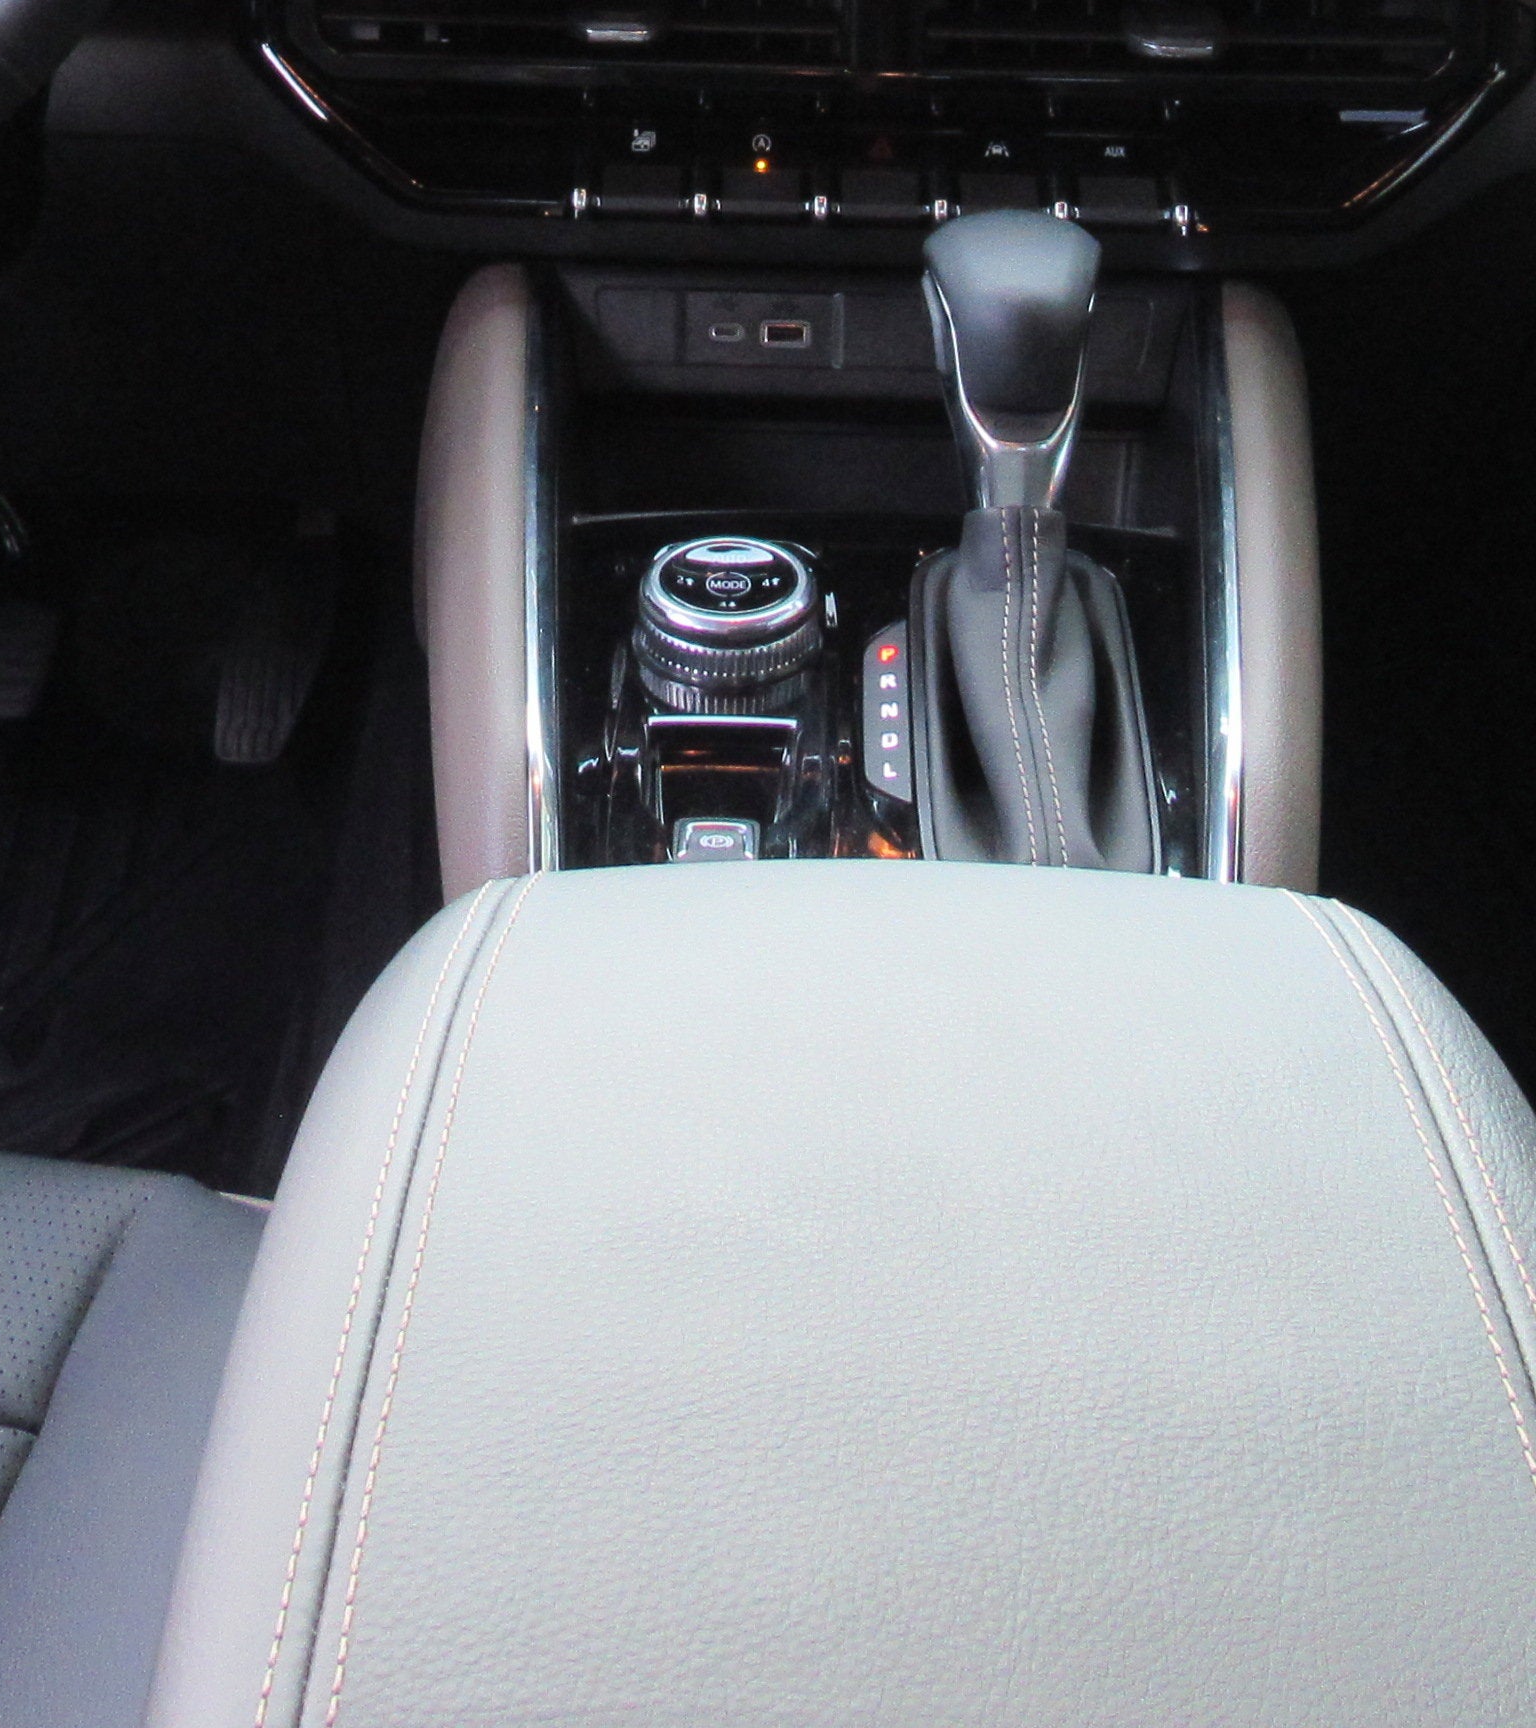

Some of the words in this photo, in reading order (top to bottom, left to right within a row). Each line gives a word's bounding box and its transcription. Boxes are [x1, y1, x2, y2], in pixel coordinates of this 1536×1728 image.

[1104, 145, 1127, 158] AUX
[710, 579, 747, 590] MODE
[877, 646, 898, 662] P
[880, 674, 897, 688] R
[881, 703, 898, 718] N
[881, 733, 898, 749] D
[882, 764, 898, 779] L
